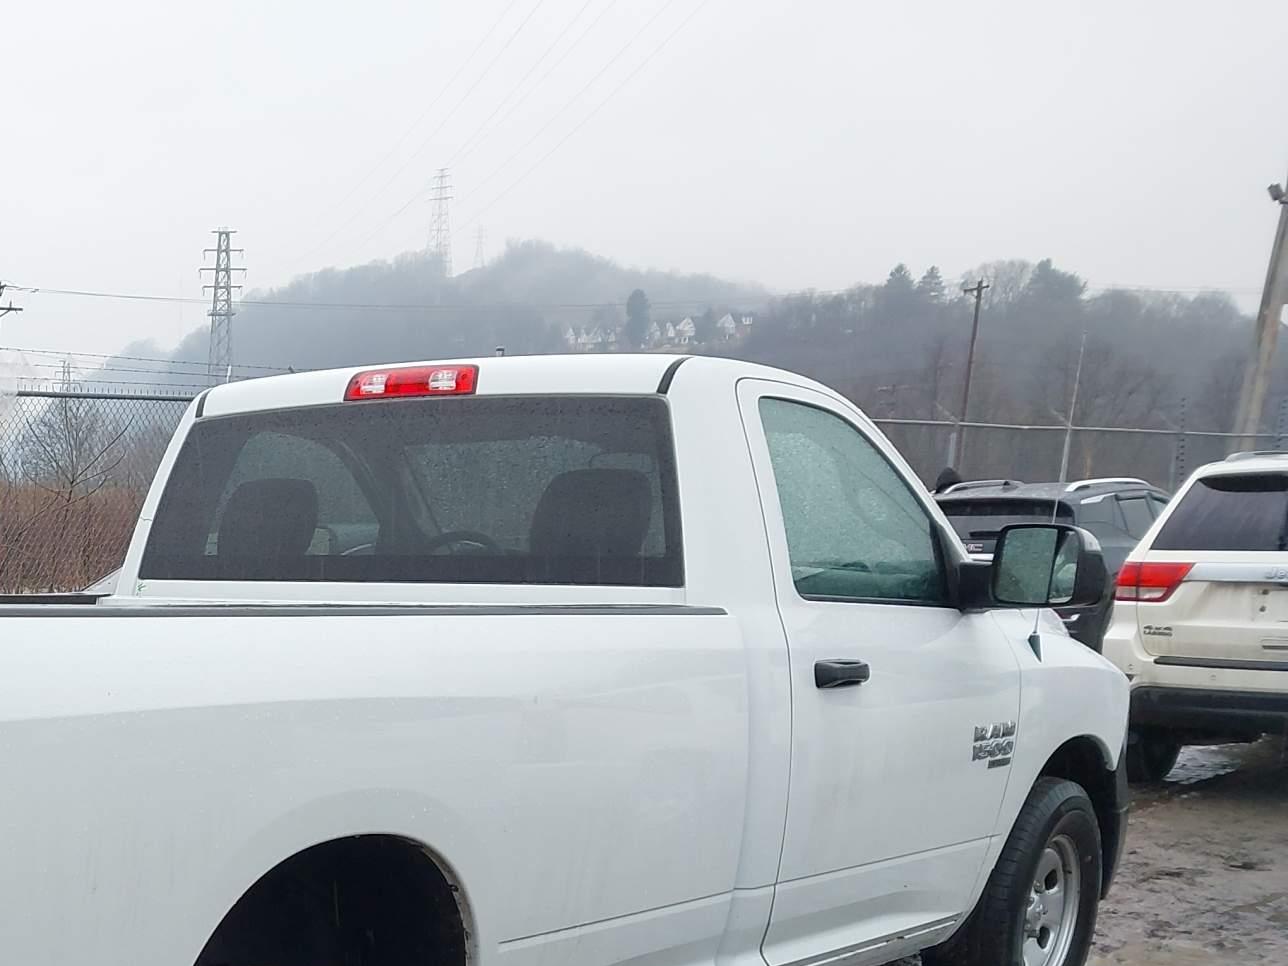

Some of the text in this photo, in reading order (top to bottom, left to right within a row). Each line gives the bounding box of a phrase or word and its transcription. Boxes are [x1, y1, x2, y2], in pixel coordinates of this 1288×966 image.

[963, 543, 983, 552] MC
[1264, 566, 1288, 580] Je
[973, 720, 1016, 742] RAM
[972, 739, 1014, 762] 1500
